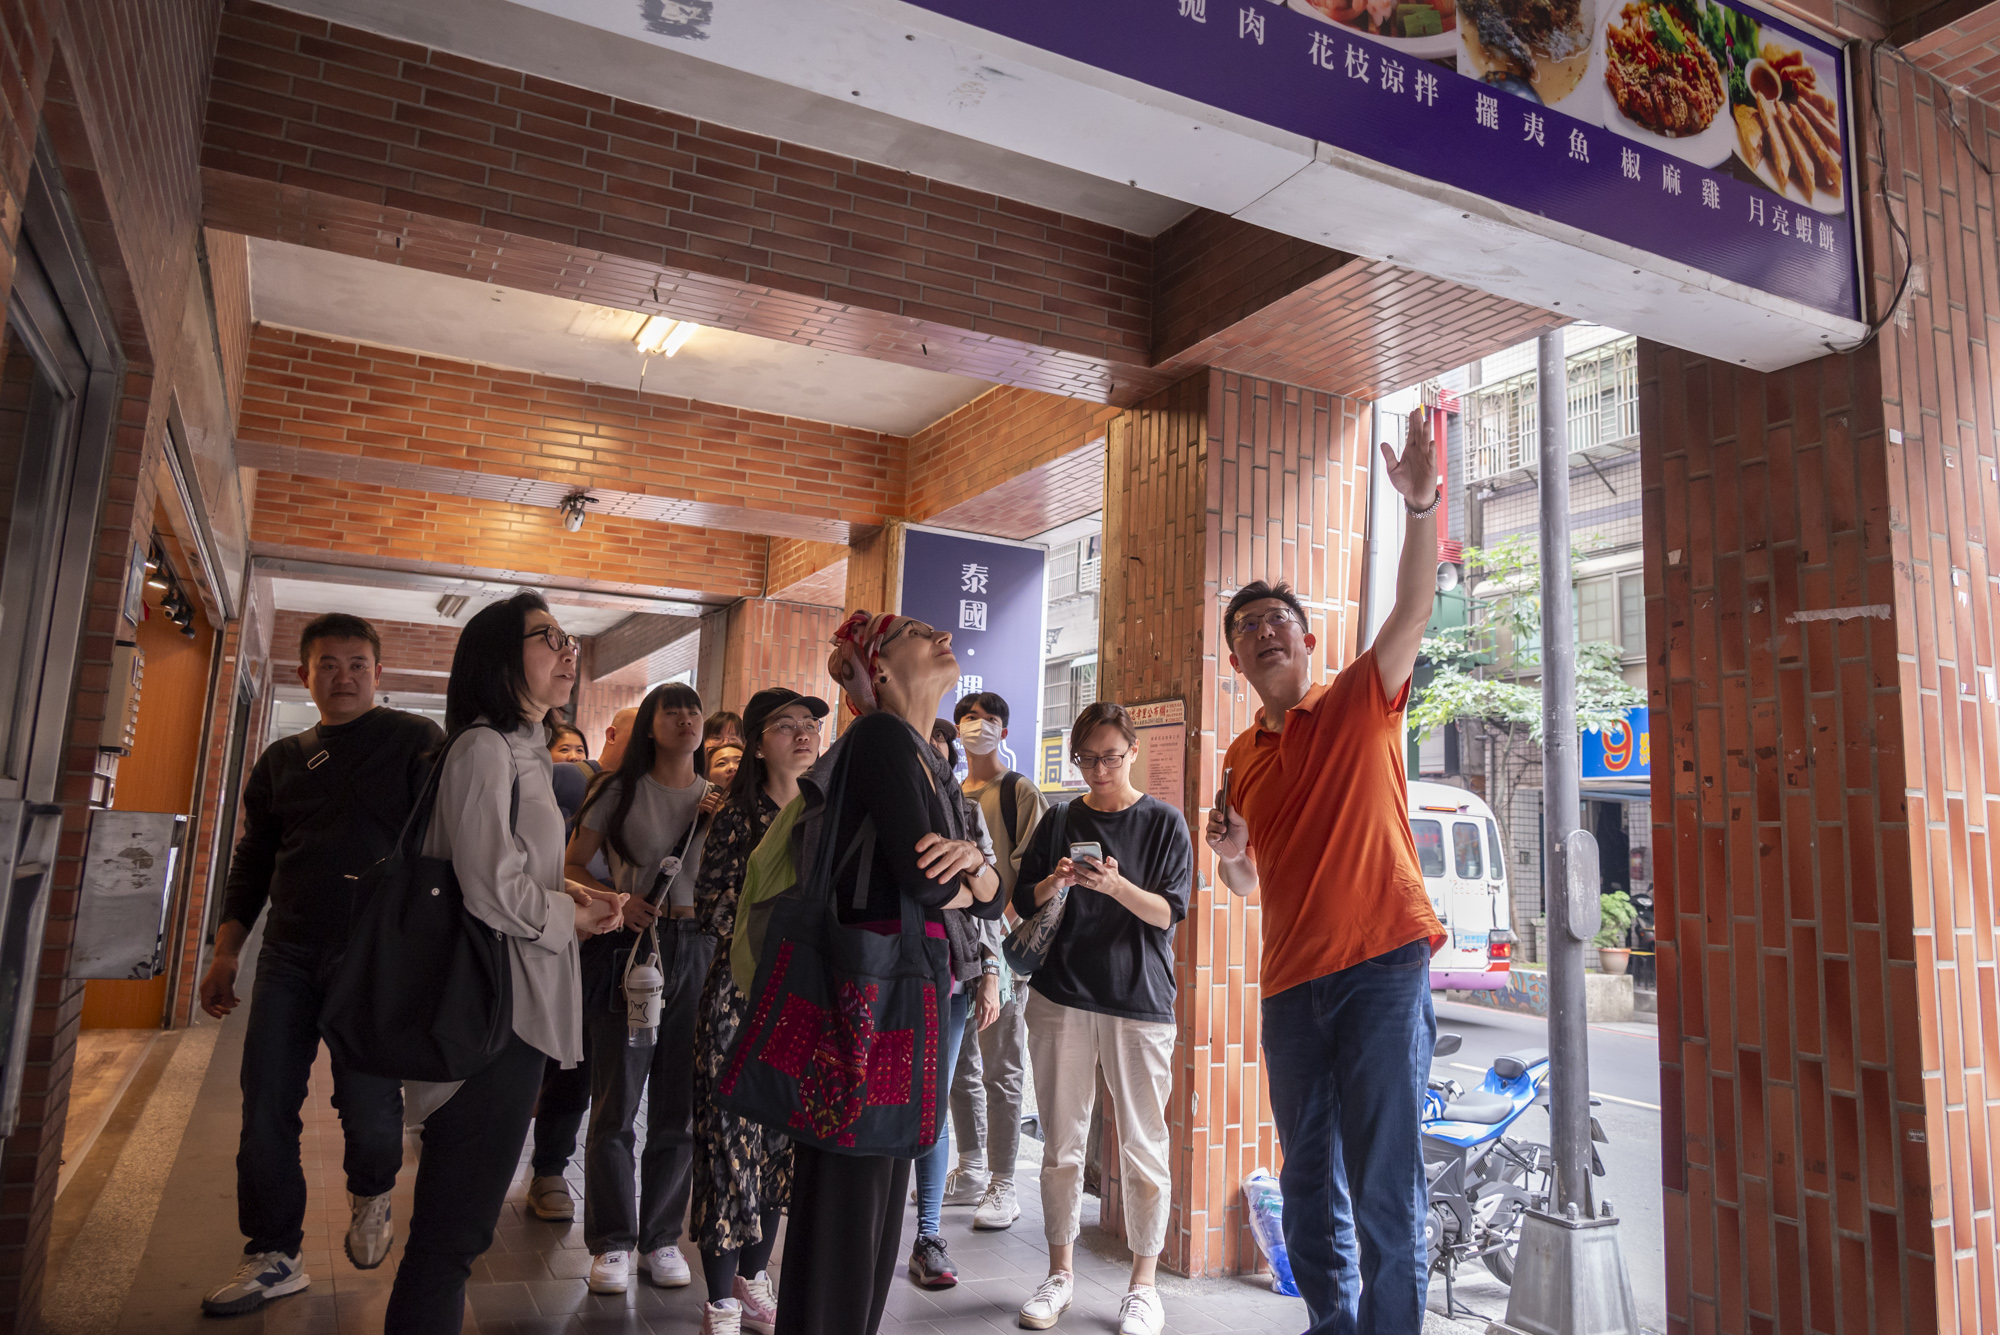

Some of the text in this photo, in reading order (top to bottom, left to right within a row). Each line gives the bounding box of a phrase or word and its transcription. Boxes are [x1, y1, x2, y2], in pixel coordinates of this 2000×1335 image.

[1308, 31, 1439, 107] 花枝涼拌
[1475, 92, 1590, 164] 擺夷魚
[1620, 146, 1721, 210] 椒麻雞
[1748, 195, 1835, 253] 月亮蝦餅
